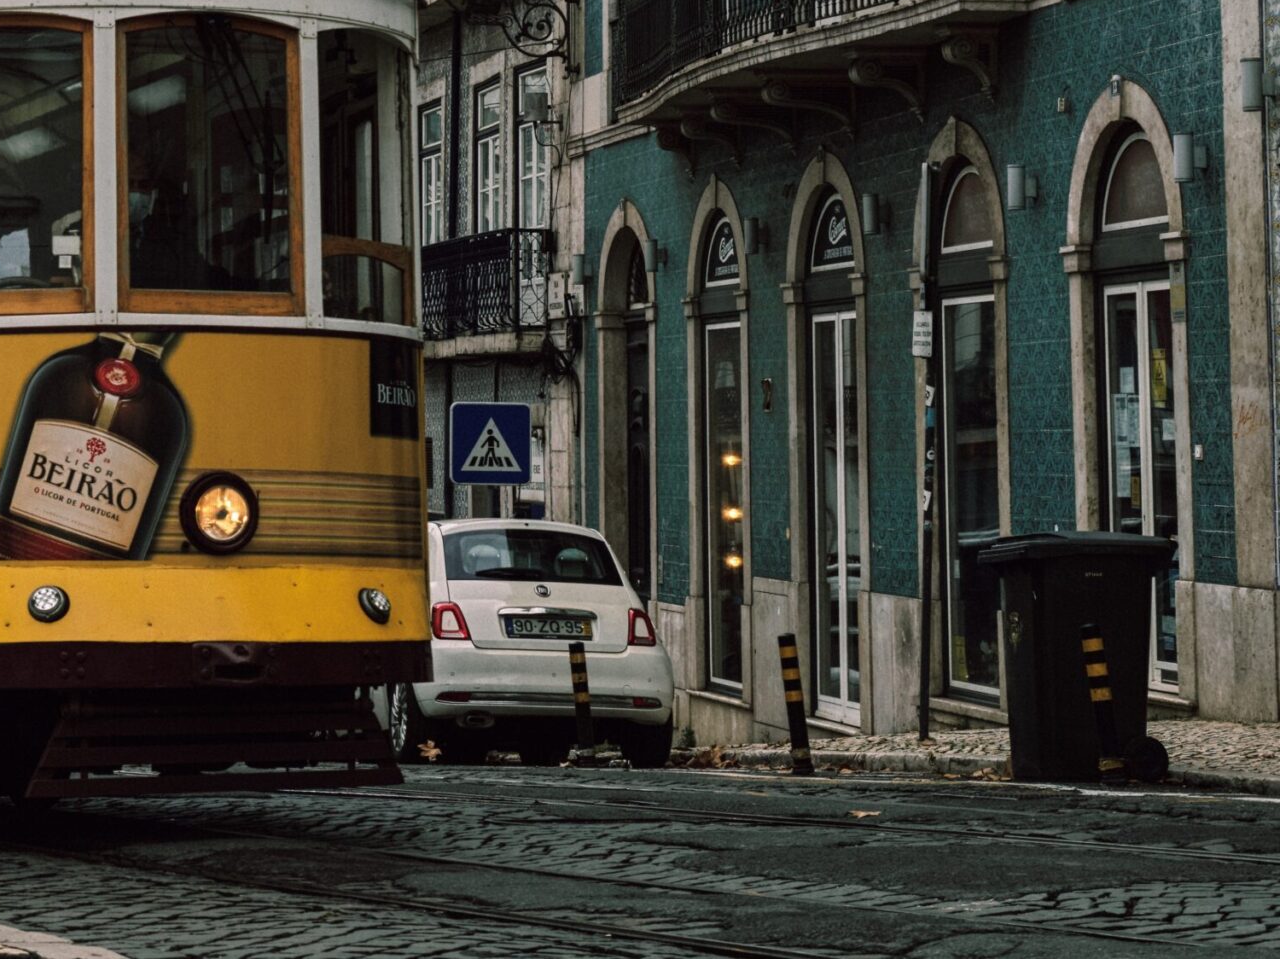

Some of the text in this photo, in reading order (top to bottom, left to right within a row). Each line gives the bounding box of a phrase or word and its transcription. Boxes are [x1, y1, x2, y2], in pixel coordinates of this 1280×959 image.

[377, 383, 416, 409] BEIRÃO
[65, 455, 113, 477] LICOR
[27, 452, 137, 512] BEIRÃO
[33, 486, 40, 494] O
[40, 488, 64, 502] LICOR
[66, 497, 77, 506] DE
[79, 502, 120, 522] PORTUGAL
